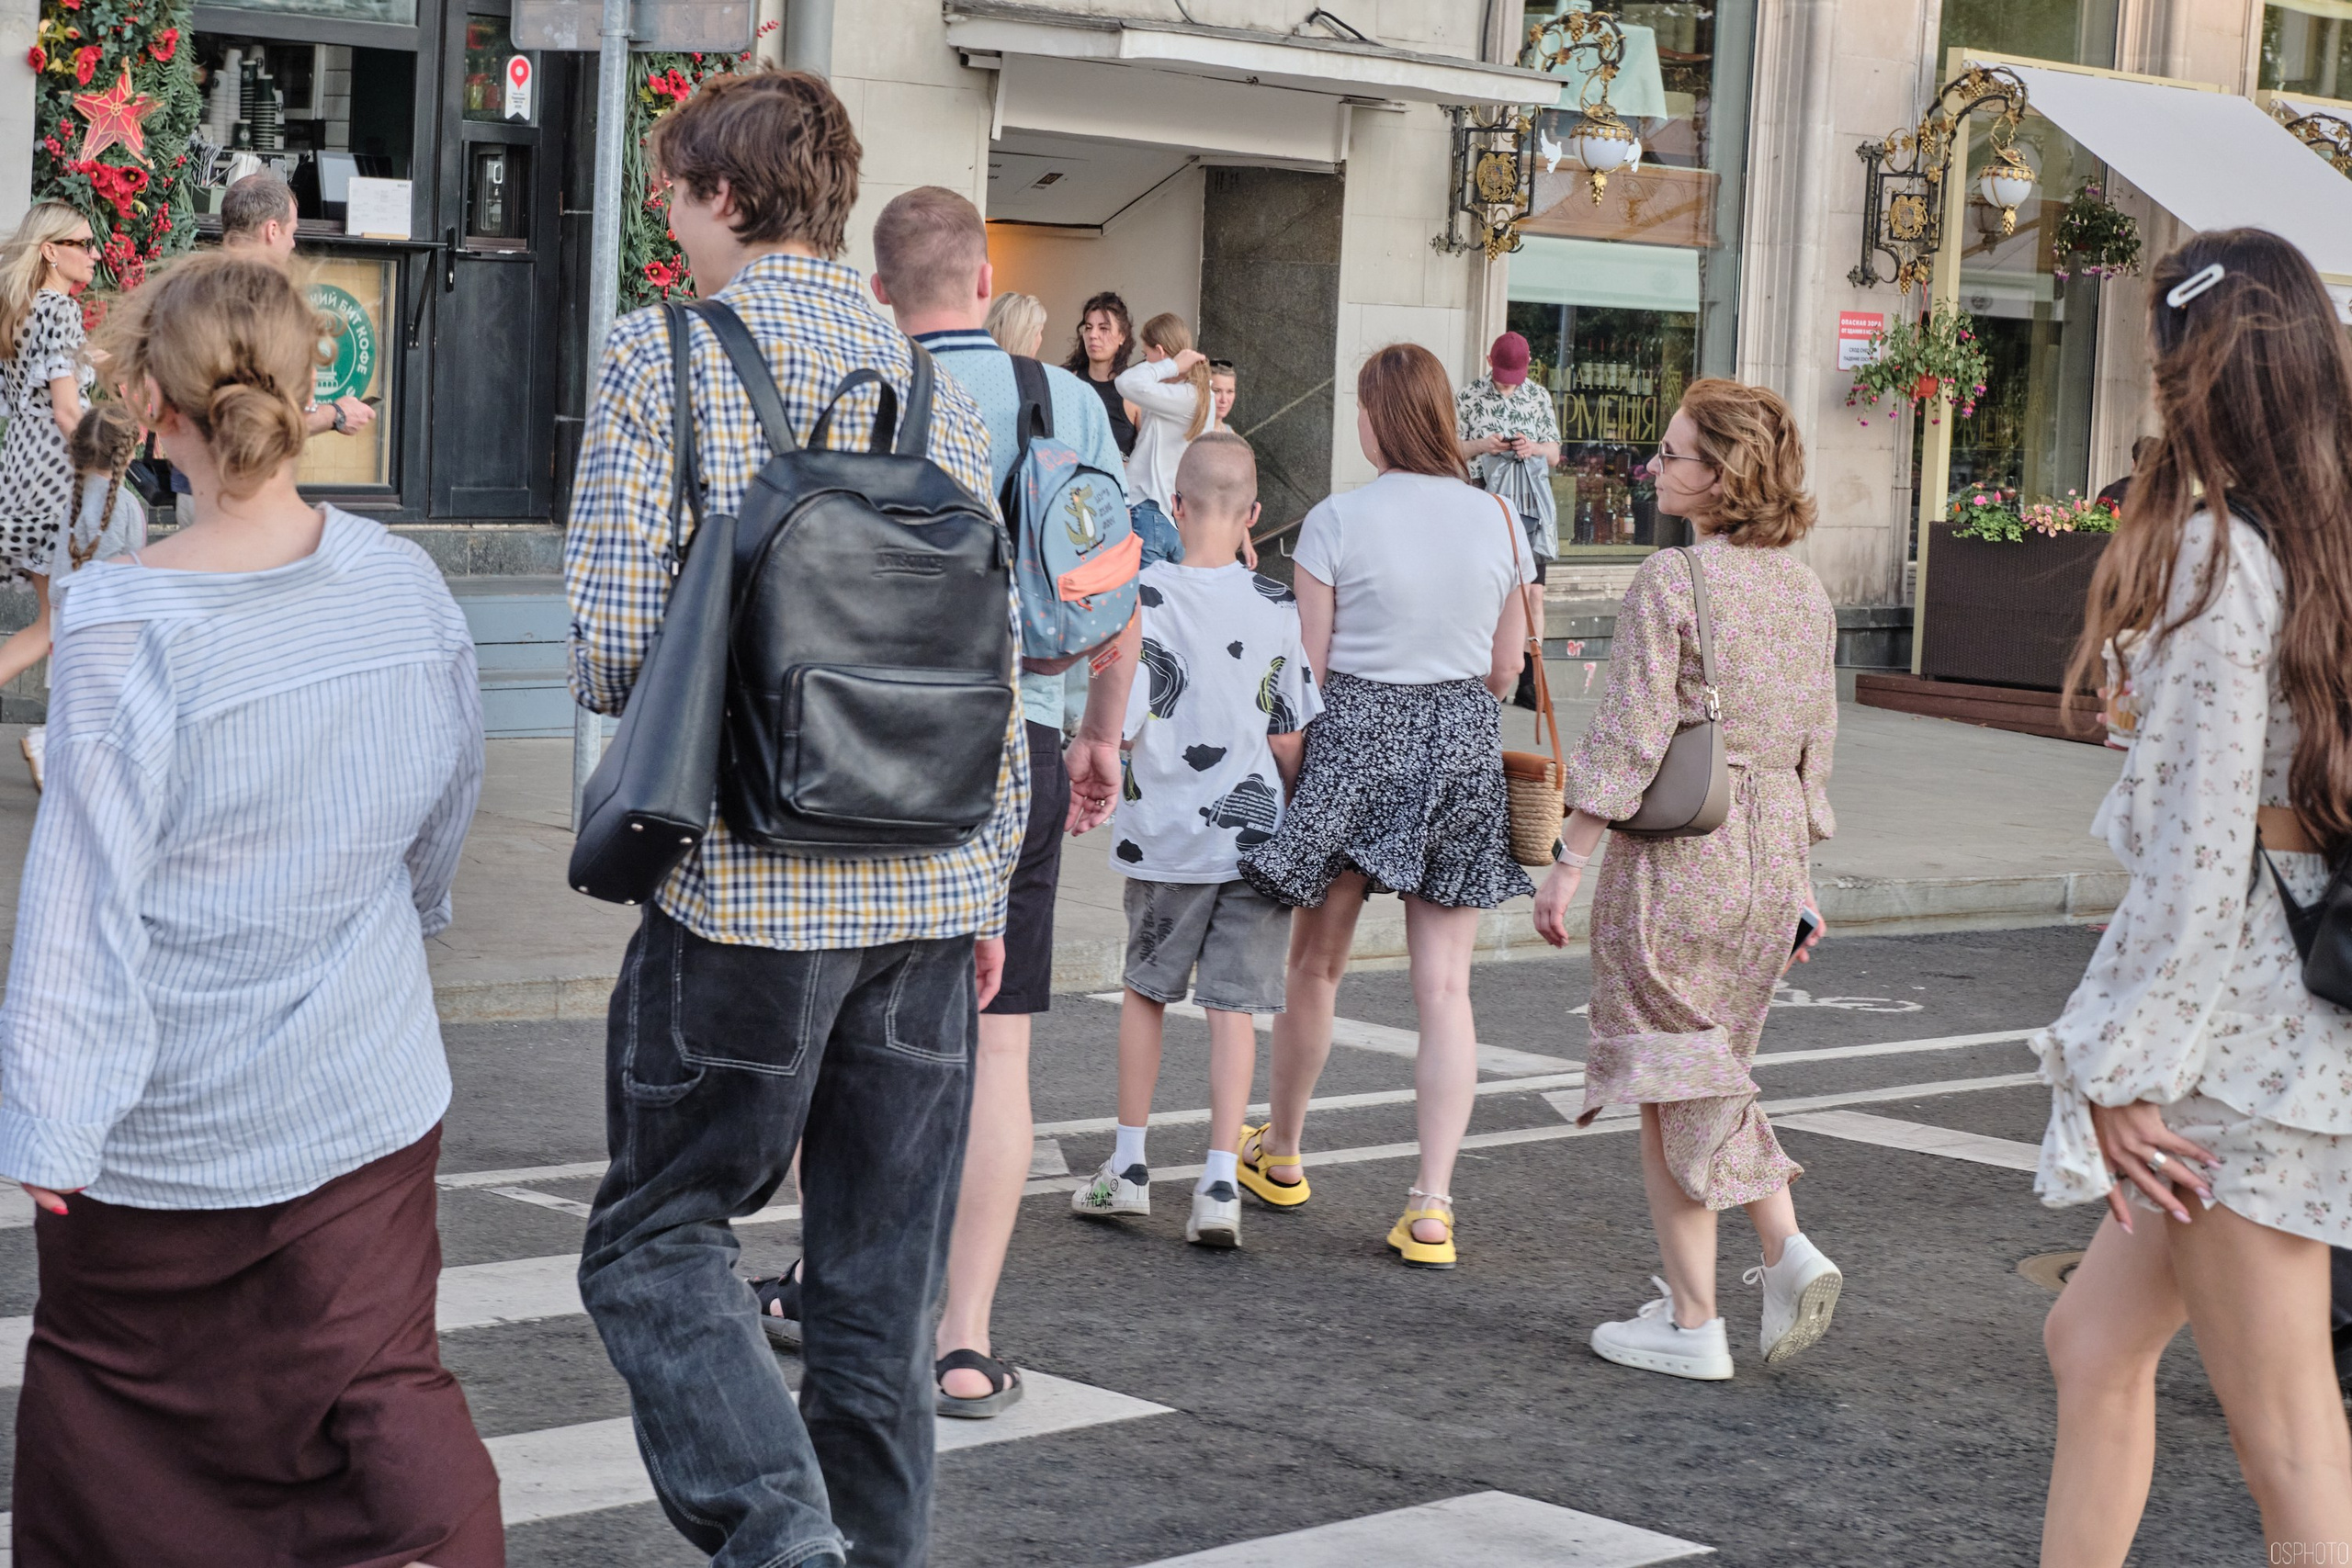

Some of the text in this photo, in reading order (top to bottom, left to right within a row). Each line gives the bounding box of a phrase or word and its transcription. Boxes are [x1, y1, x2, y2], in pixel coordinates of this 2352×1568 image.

[338, 298, 370, 375] БИТ КОФЕ
[1557, 367, 1653, 392] МАГАЗИН
